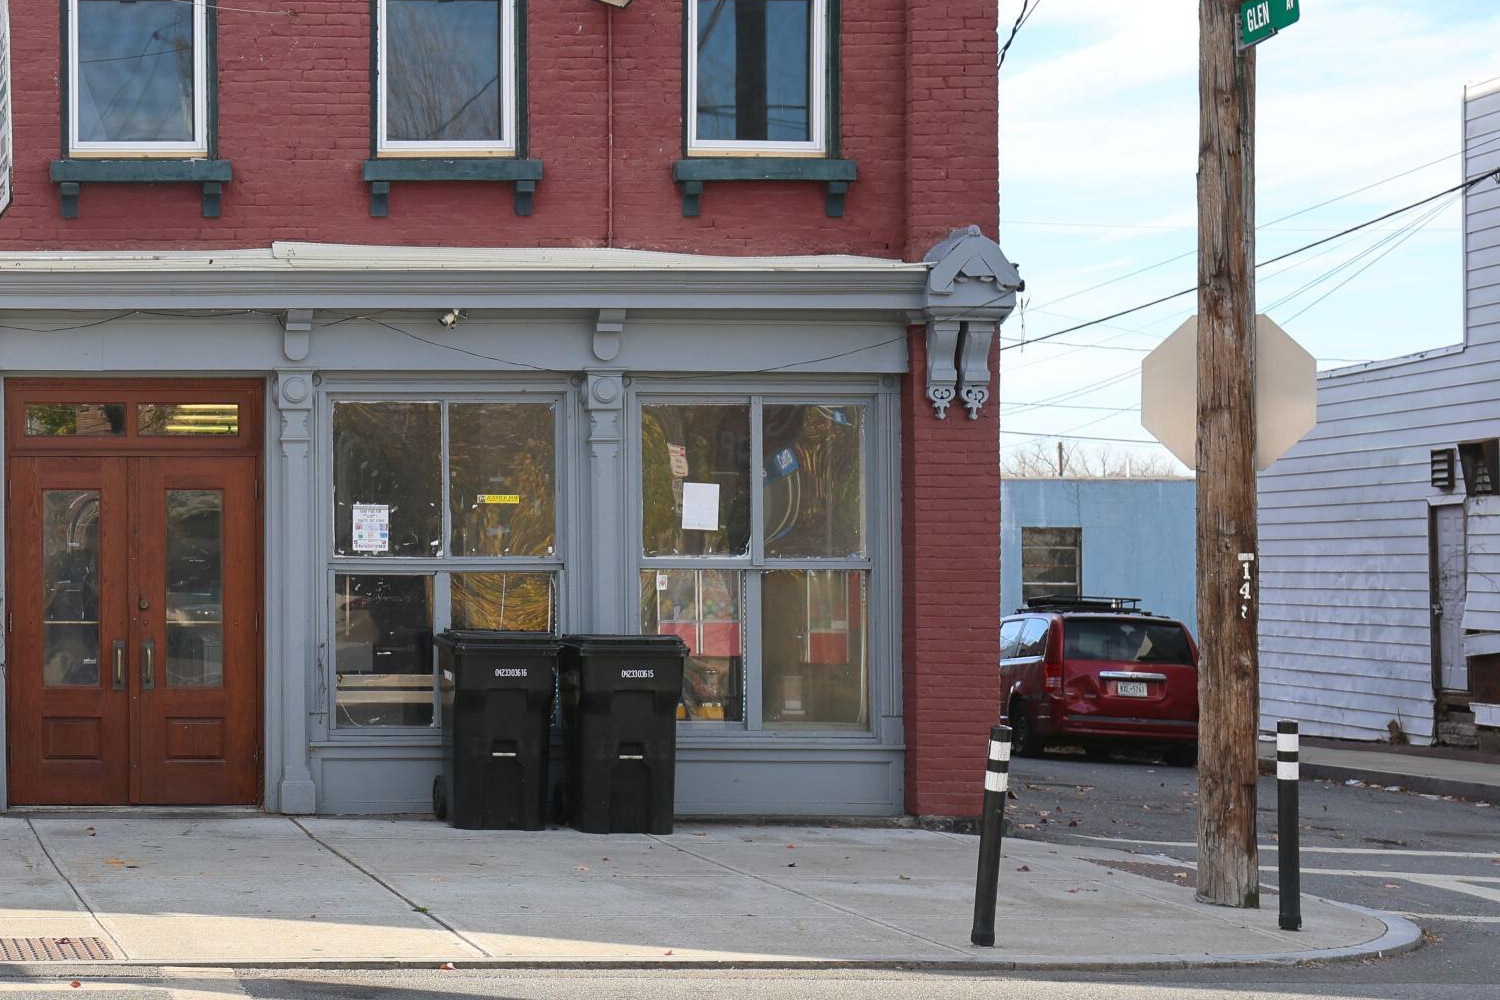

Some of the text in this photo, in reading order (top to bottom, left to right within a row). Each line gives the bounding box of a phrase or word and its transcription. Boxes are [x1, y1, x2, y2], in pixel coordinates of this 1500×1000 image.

[1246, 0, 1270, 33] GLEN
[494, 668, 528, 677] 0423303616
[621, 669, 654, 678] 0423303615
